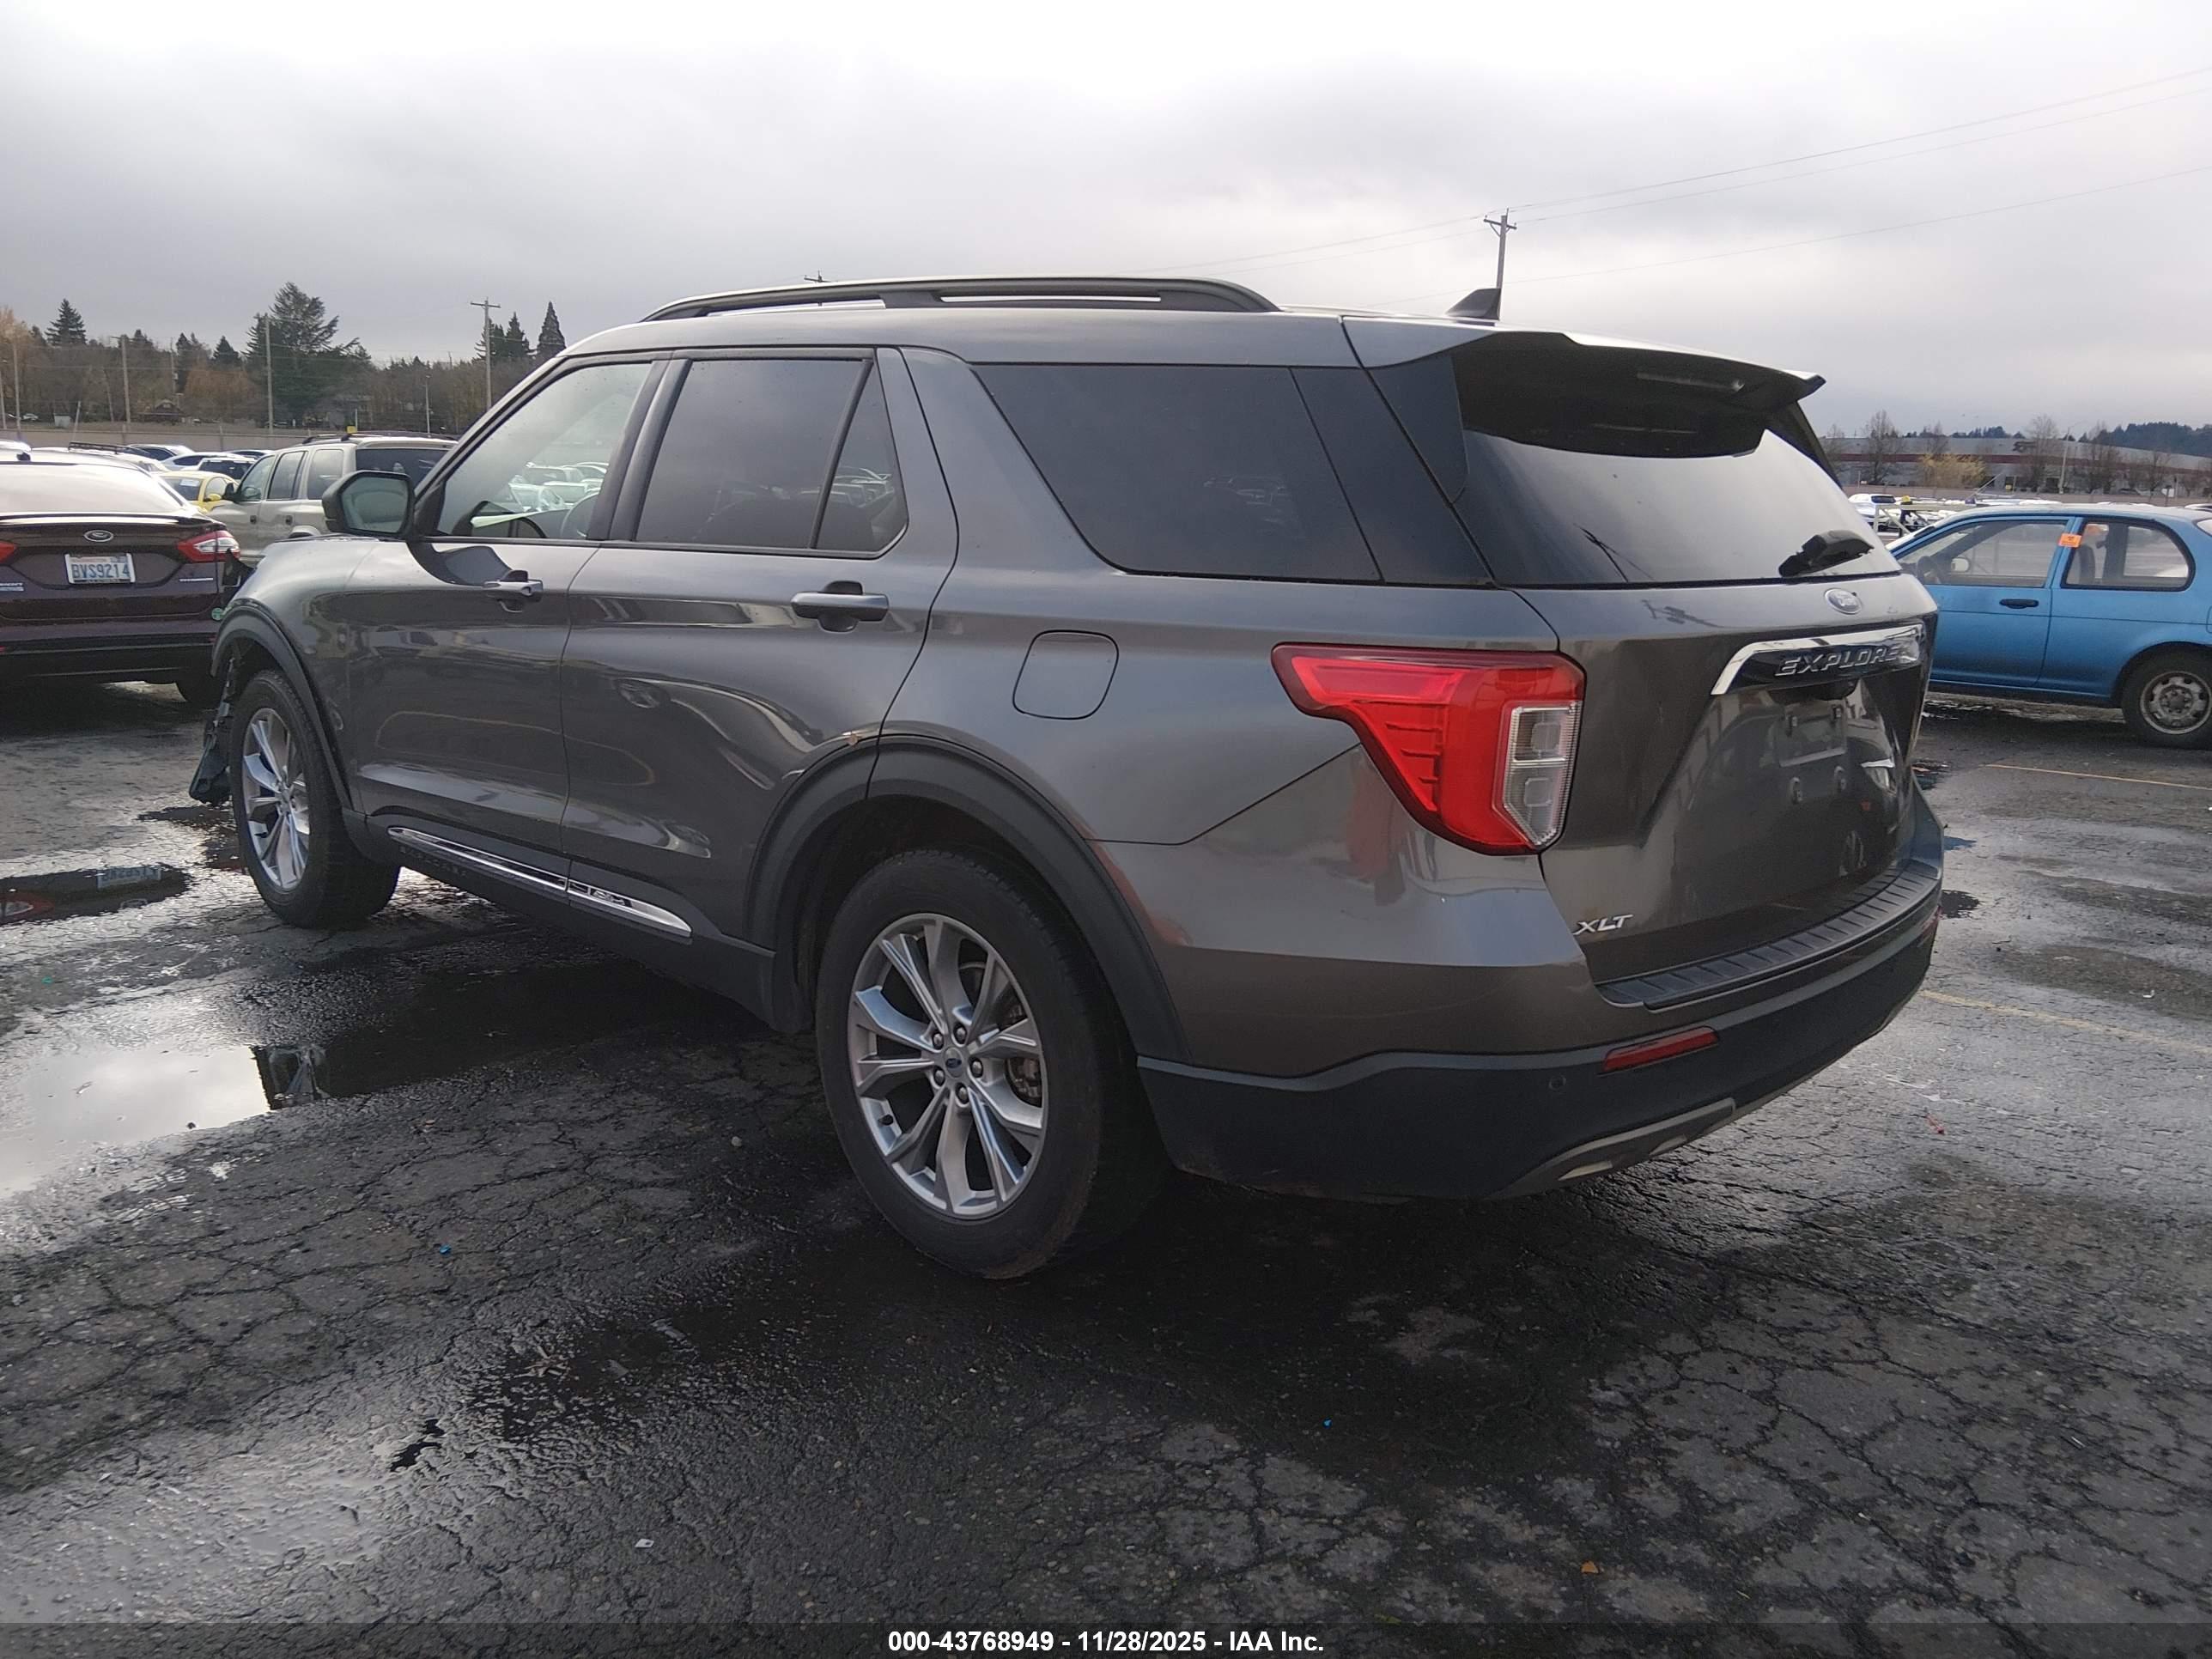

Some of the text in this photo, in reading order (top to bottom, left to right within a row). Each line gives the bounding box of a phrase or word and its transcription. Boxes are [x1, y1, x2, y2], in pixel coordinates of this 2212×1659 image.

[71, 562, 130, 579] BVS9214
[1774, 642, 1914, 677] EXPLORE
[1571, 914, 1633, 935] XLT
